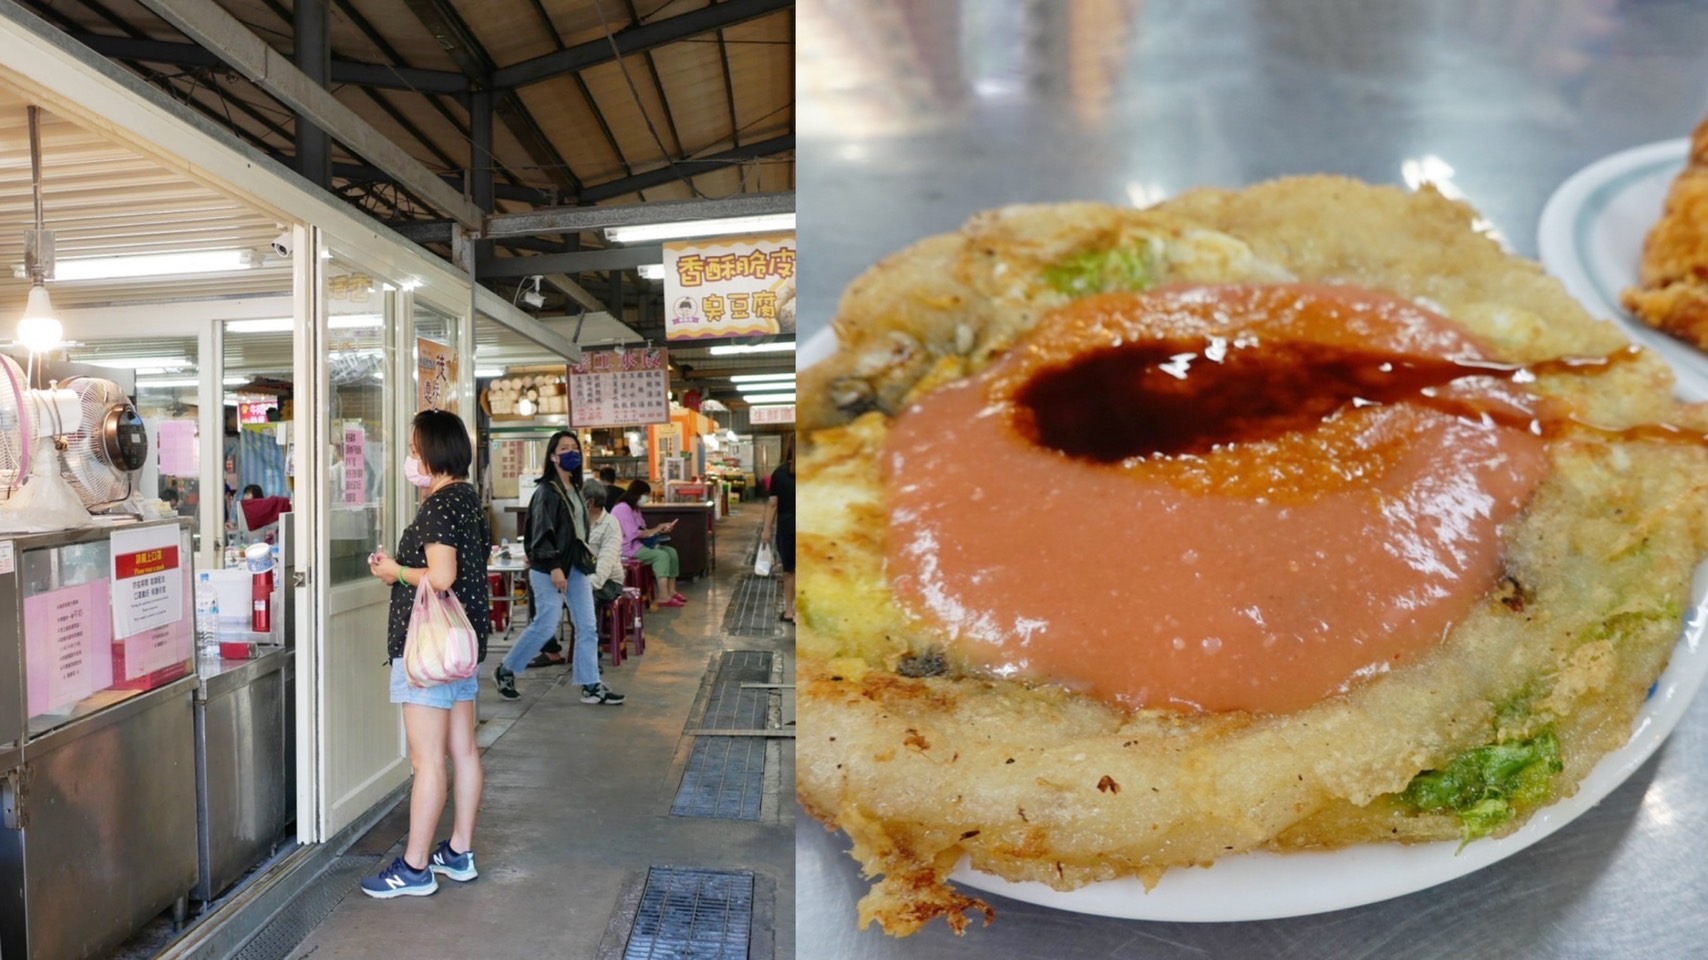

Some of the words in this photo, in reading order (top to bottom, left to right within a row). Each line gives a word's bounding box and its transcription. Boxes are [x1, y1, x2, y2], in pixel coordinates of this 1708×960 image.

[677, 247, 796, 287] 香酥脆皮
[701, 290, 777, 322] 臭豆腐
[753, 408, 793, 422] 生鮮區
[385, 874, 406, 889] N
